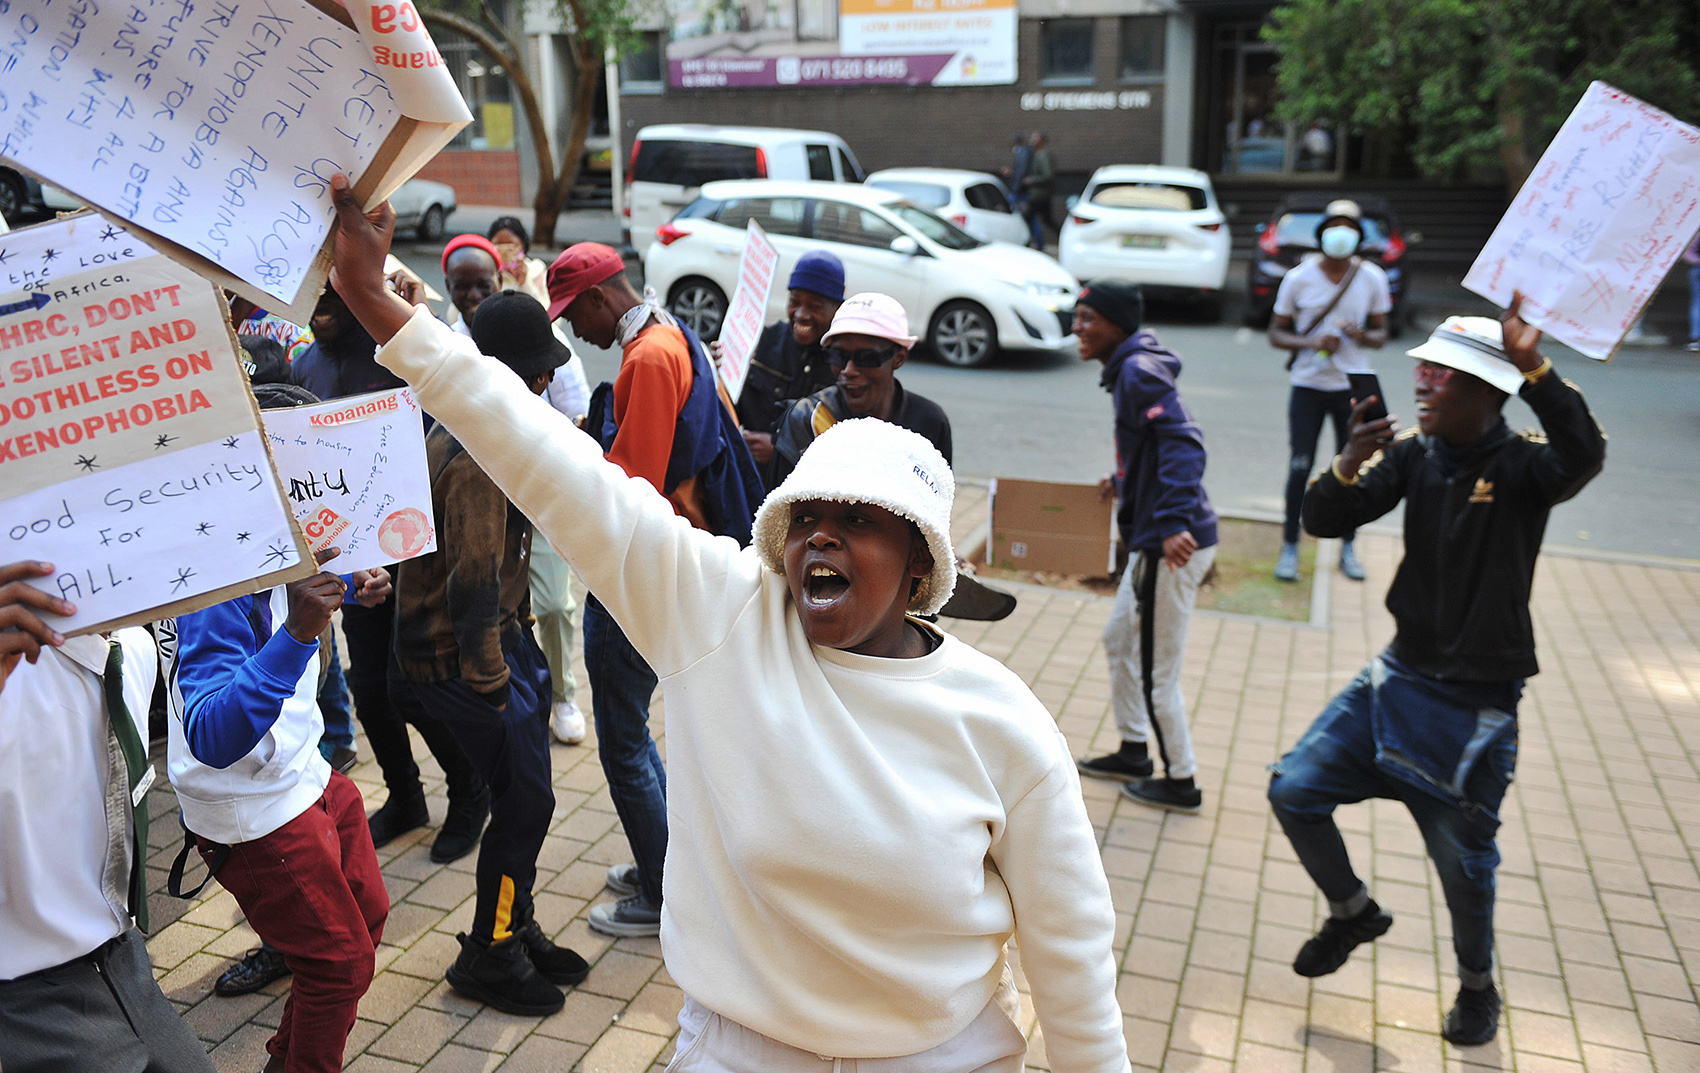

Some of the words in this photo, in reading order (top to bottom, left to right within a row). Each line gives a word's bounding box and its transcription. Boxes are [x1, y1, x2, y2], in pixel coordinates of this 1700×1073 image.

[135, 0, 194, 91] FUTURE
[188, 1, 239, 67] TRIVE
[373, 45, 444, 69] nang
[105, 96, 136, 119] 4
[153, 76, 194, 121] FOR
[261, 36, 342, 140] UNITE
[92, 131, 125, 172] ALL
[139, 131, 166, 154] A
[294, 158, 342, 198] US
[1591, 126, 1664, 211] RIGHTS
[153, 176, 191, 224] AND
[197, 145, 269, 262] AGAINST
[0, 313, 80, 352] HRC,
[83, 284, 181, 329] DON'T
[10, 335, 121, 384] SILENT
[130, 318, 196, 354] AND
[165, 350, 213, 380] ON
[0, 389, 212, 464] XENOPHOBIA
[310, 394, 398, 426] Kopanang
[104, 463, 262, 513] Security
